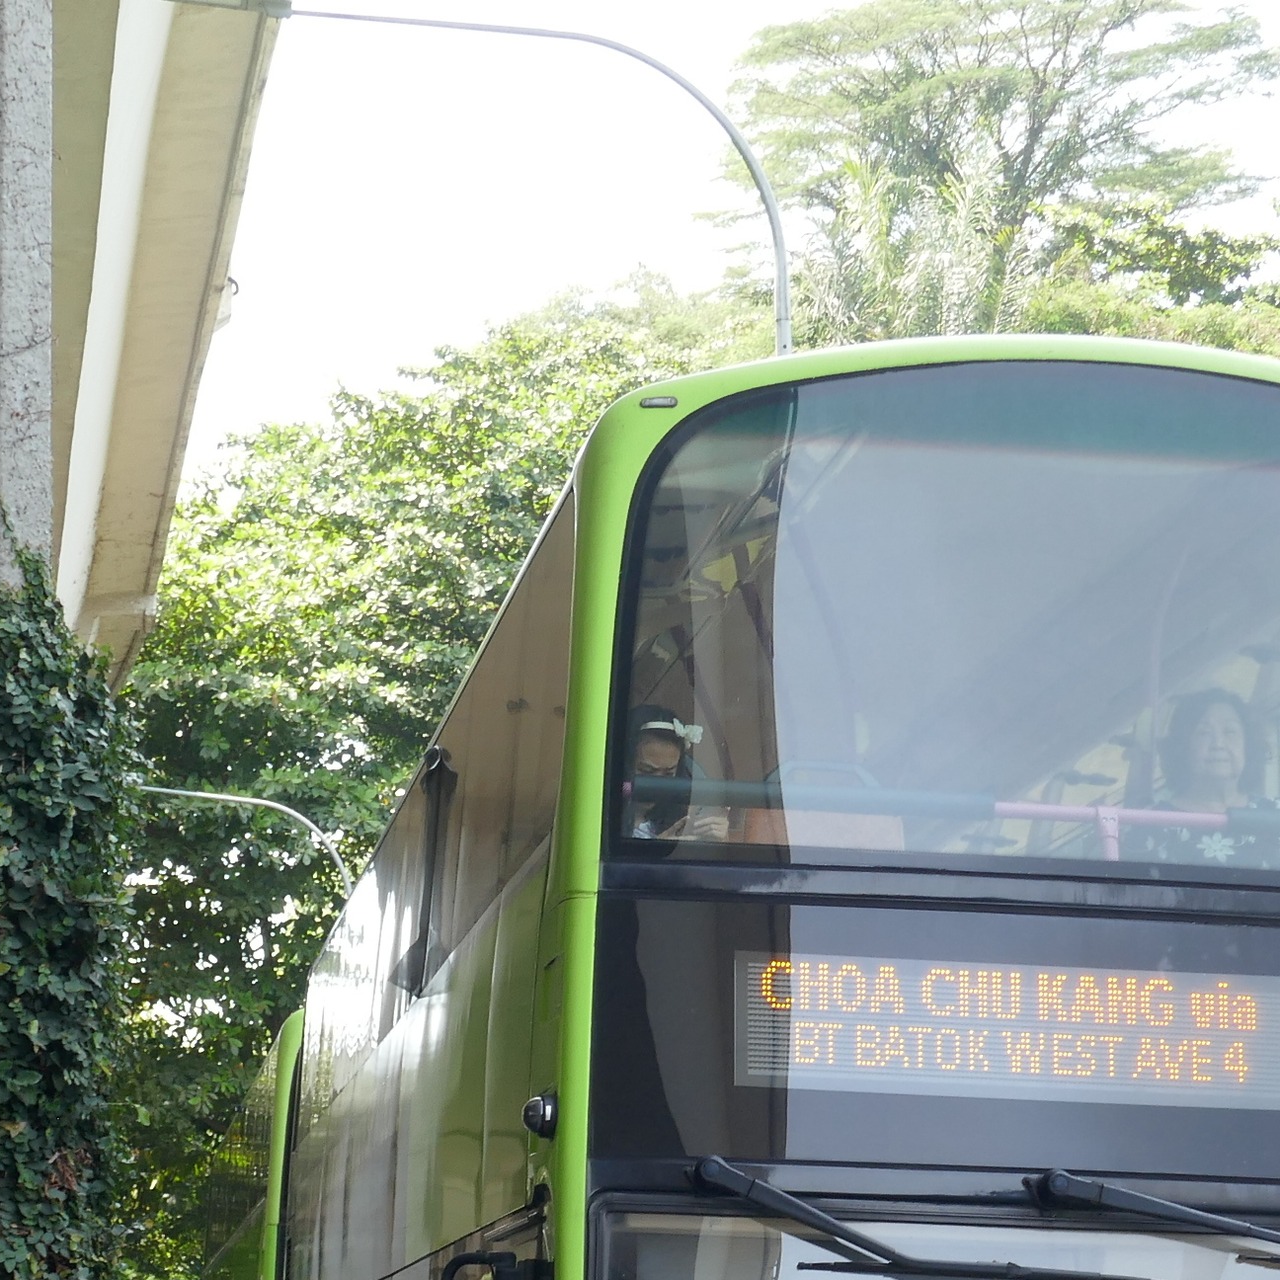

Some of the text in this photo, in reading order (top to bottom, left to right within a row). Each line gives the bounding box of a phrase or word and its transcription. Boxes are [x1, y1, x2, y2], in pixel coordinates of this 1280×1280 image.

[761, 960, 1257, 1031] CHOA CHU KANG via
[794, 1021, 1249, 1083] BT BATOK WEST AVE 4
